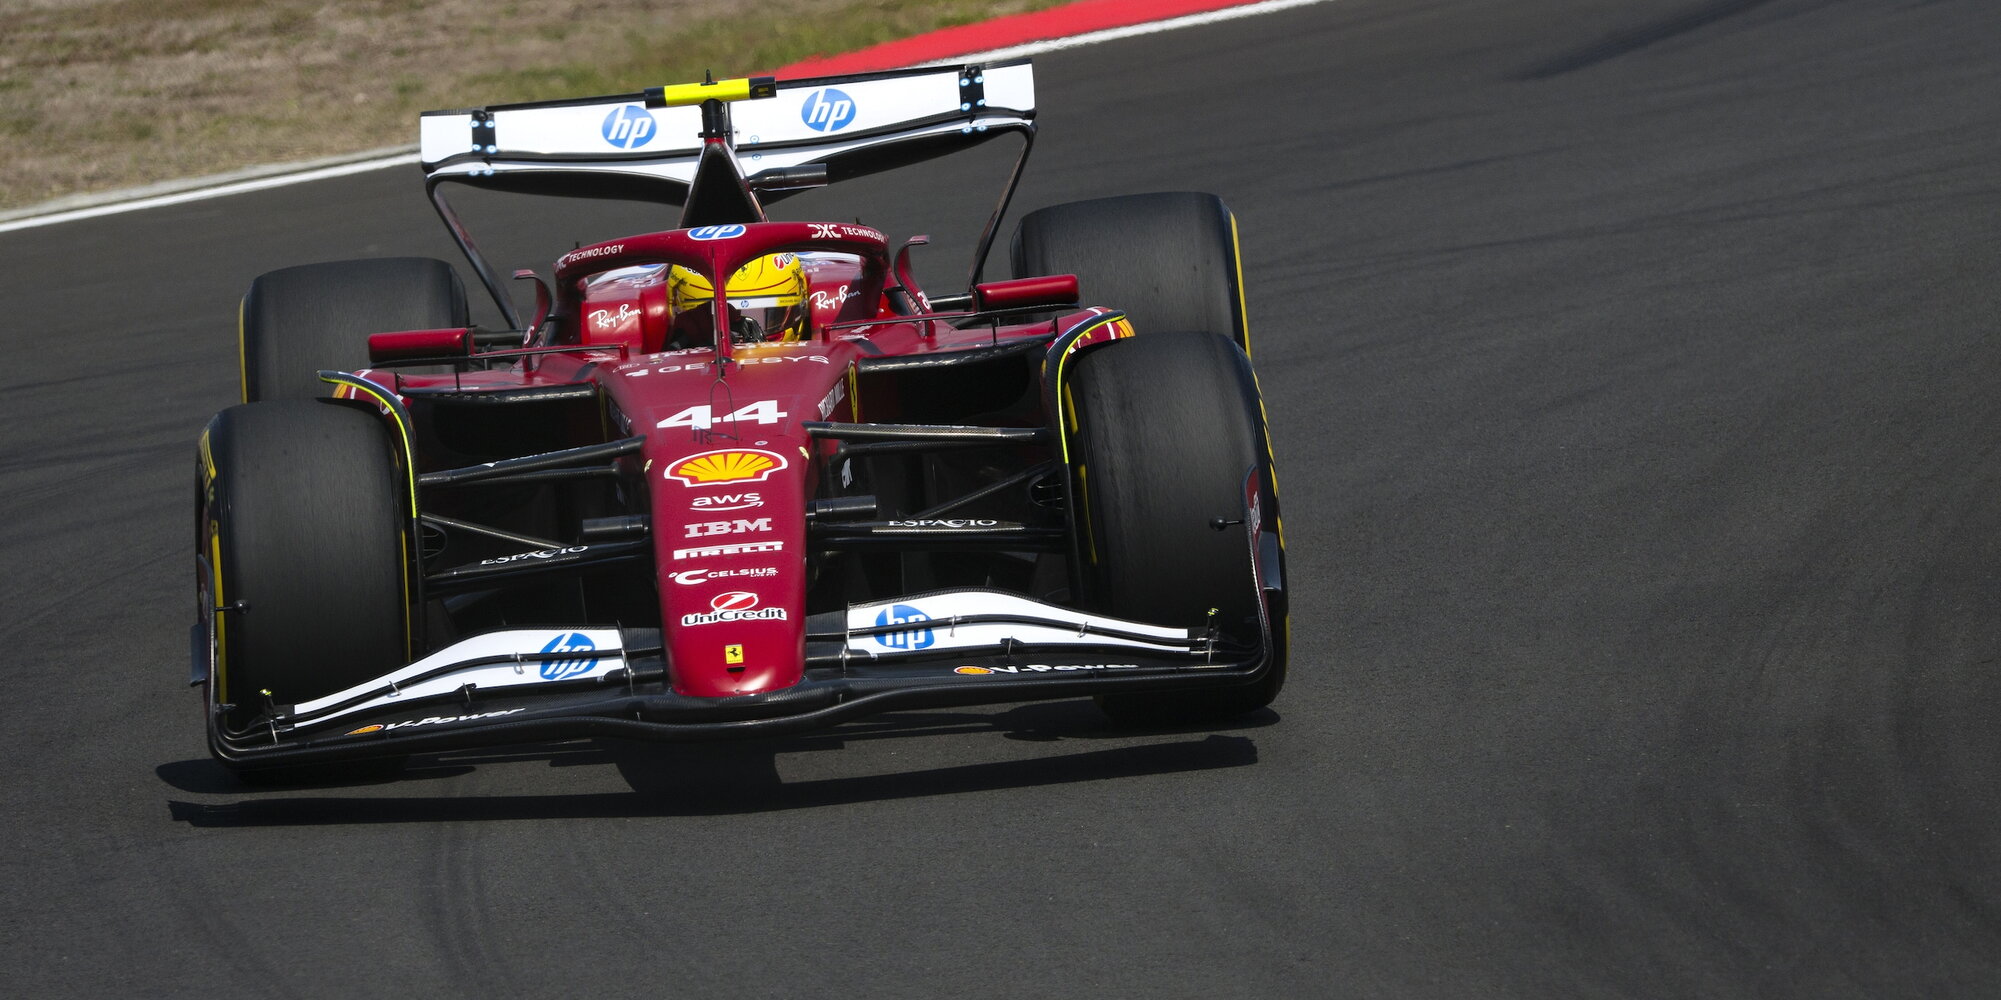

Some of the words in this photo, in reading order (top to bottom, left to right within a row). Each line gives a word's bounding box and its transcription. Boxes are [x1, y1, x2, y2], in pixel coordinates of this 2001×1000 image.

[807, 88, 852, 132] hp
[606, 105, 653, 149] hp
[568, 244, 624, 263] TECHNOLOGY
[809, 285, 861, 310] Ray-Ban
[588, 303, 641, 328] Ray-Ban
[658, 355, 829, 373] GEESYS
[656, 399, 787, 430] 44
[692, 492, 761, 507] aws
[684, 517, 773, 538] IBM
[673, 541, 785, 560] PIRELLI
[683, 608, 786, 626] UniCredit
[885, 604, 927, 650] hp
[543, 633, 593, 680] hp
[988, 663, 1140, 674] V-Power
[384, 707, 526, 731] V-Power
